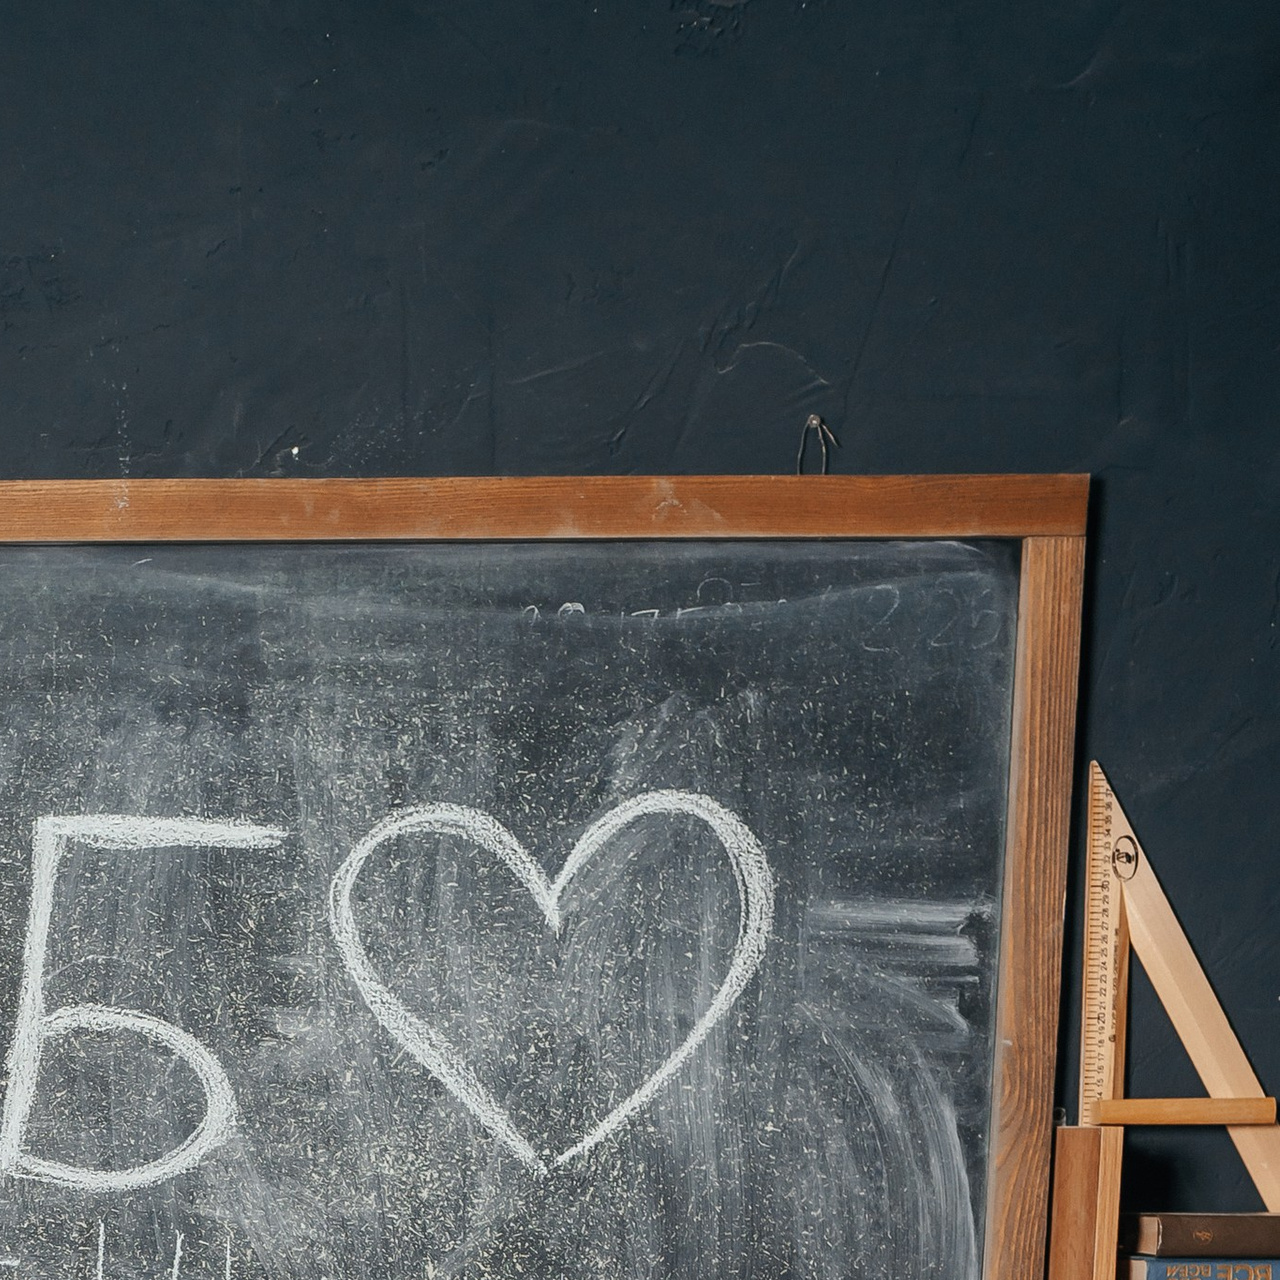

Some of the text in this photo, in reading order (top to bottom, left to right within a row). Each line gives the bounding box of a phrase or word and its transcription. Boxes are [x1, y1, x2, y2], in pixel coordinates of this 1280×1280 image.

[1105, 788, 1112, 798] 37
[1105, 801, 1112, 812] 36
[1105, 815, 1112, 825] 35
[1104, 828, 1111, 837] 34
[1104, 841, 1111, 852] 33
[1103, 854, 1111, 865] 32
[1103, 868, 1110, 878] 31
[1101, 880, 1110, 892] 30
[1102, 894, 1110, 905] 29
[1102, 908, 1109, 918] 28
[1102, 921, 1109, 930] 27
[1101, 934, 1108, 944] 26
[1101, 947, 1108, 958] 25
[1100, 961, 1107, 971] 24
[1100, 974, 1107, 984] 23
[1099, 987, 1107, 997] 22
[1099, 1001, 1106, 1010] 21
[1097, 1012, 1106, 1024] 20
[1098, 1025, 1105, 1035] 19
[1098, 1039, 1105, 1048] 18
[1097, 1052, 1105, 1061] 17
[1097, 1065, 1104, 1074] 16
[1097, 1078, 1104, 1088] 15
